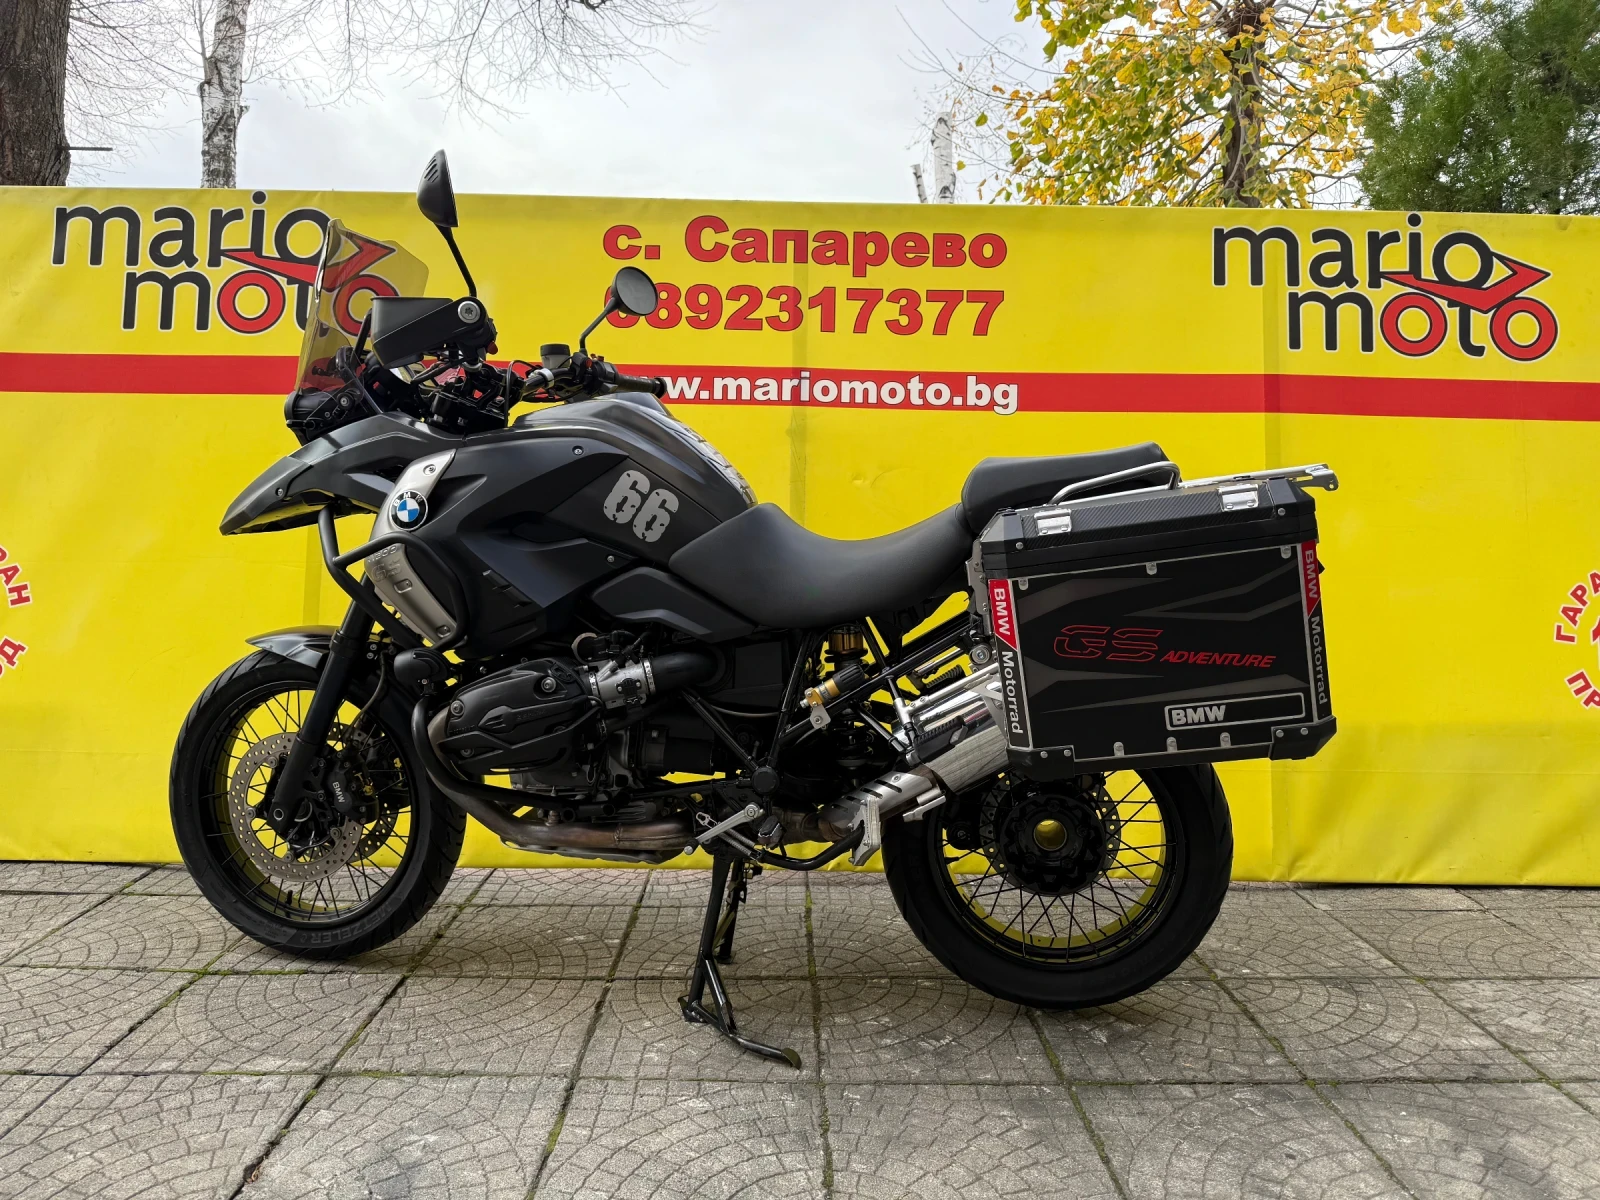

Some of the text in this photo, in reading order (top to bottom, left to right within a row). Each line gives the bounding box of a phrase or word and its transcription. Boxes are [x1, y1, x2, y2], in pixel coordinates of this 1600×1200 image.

[53, 190, 338, 269] mario
[603, 215, 1008, 278] с. Сапарево
[1213, 212, 1494, 289] mario
[122, 269, 400, 335] moto
[1288, 291, 1558, 361] moto
[603, 469, 680, 543] 66
[993, 587, 1024, 735] BMW Motorrad
[1053, 624, 1277, 668] GS ADVENTURE
[1304, 548, 1328, 706] BMW Motorrad
[1171, 704, 1226, 726] BMW
[332, 781, 346, 803] BMW
[310, 902, 394, 945] METZELER
